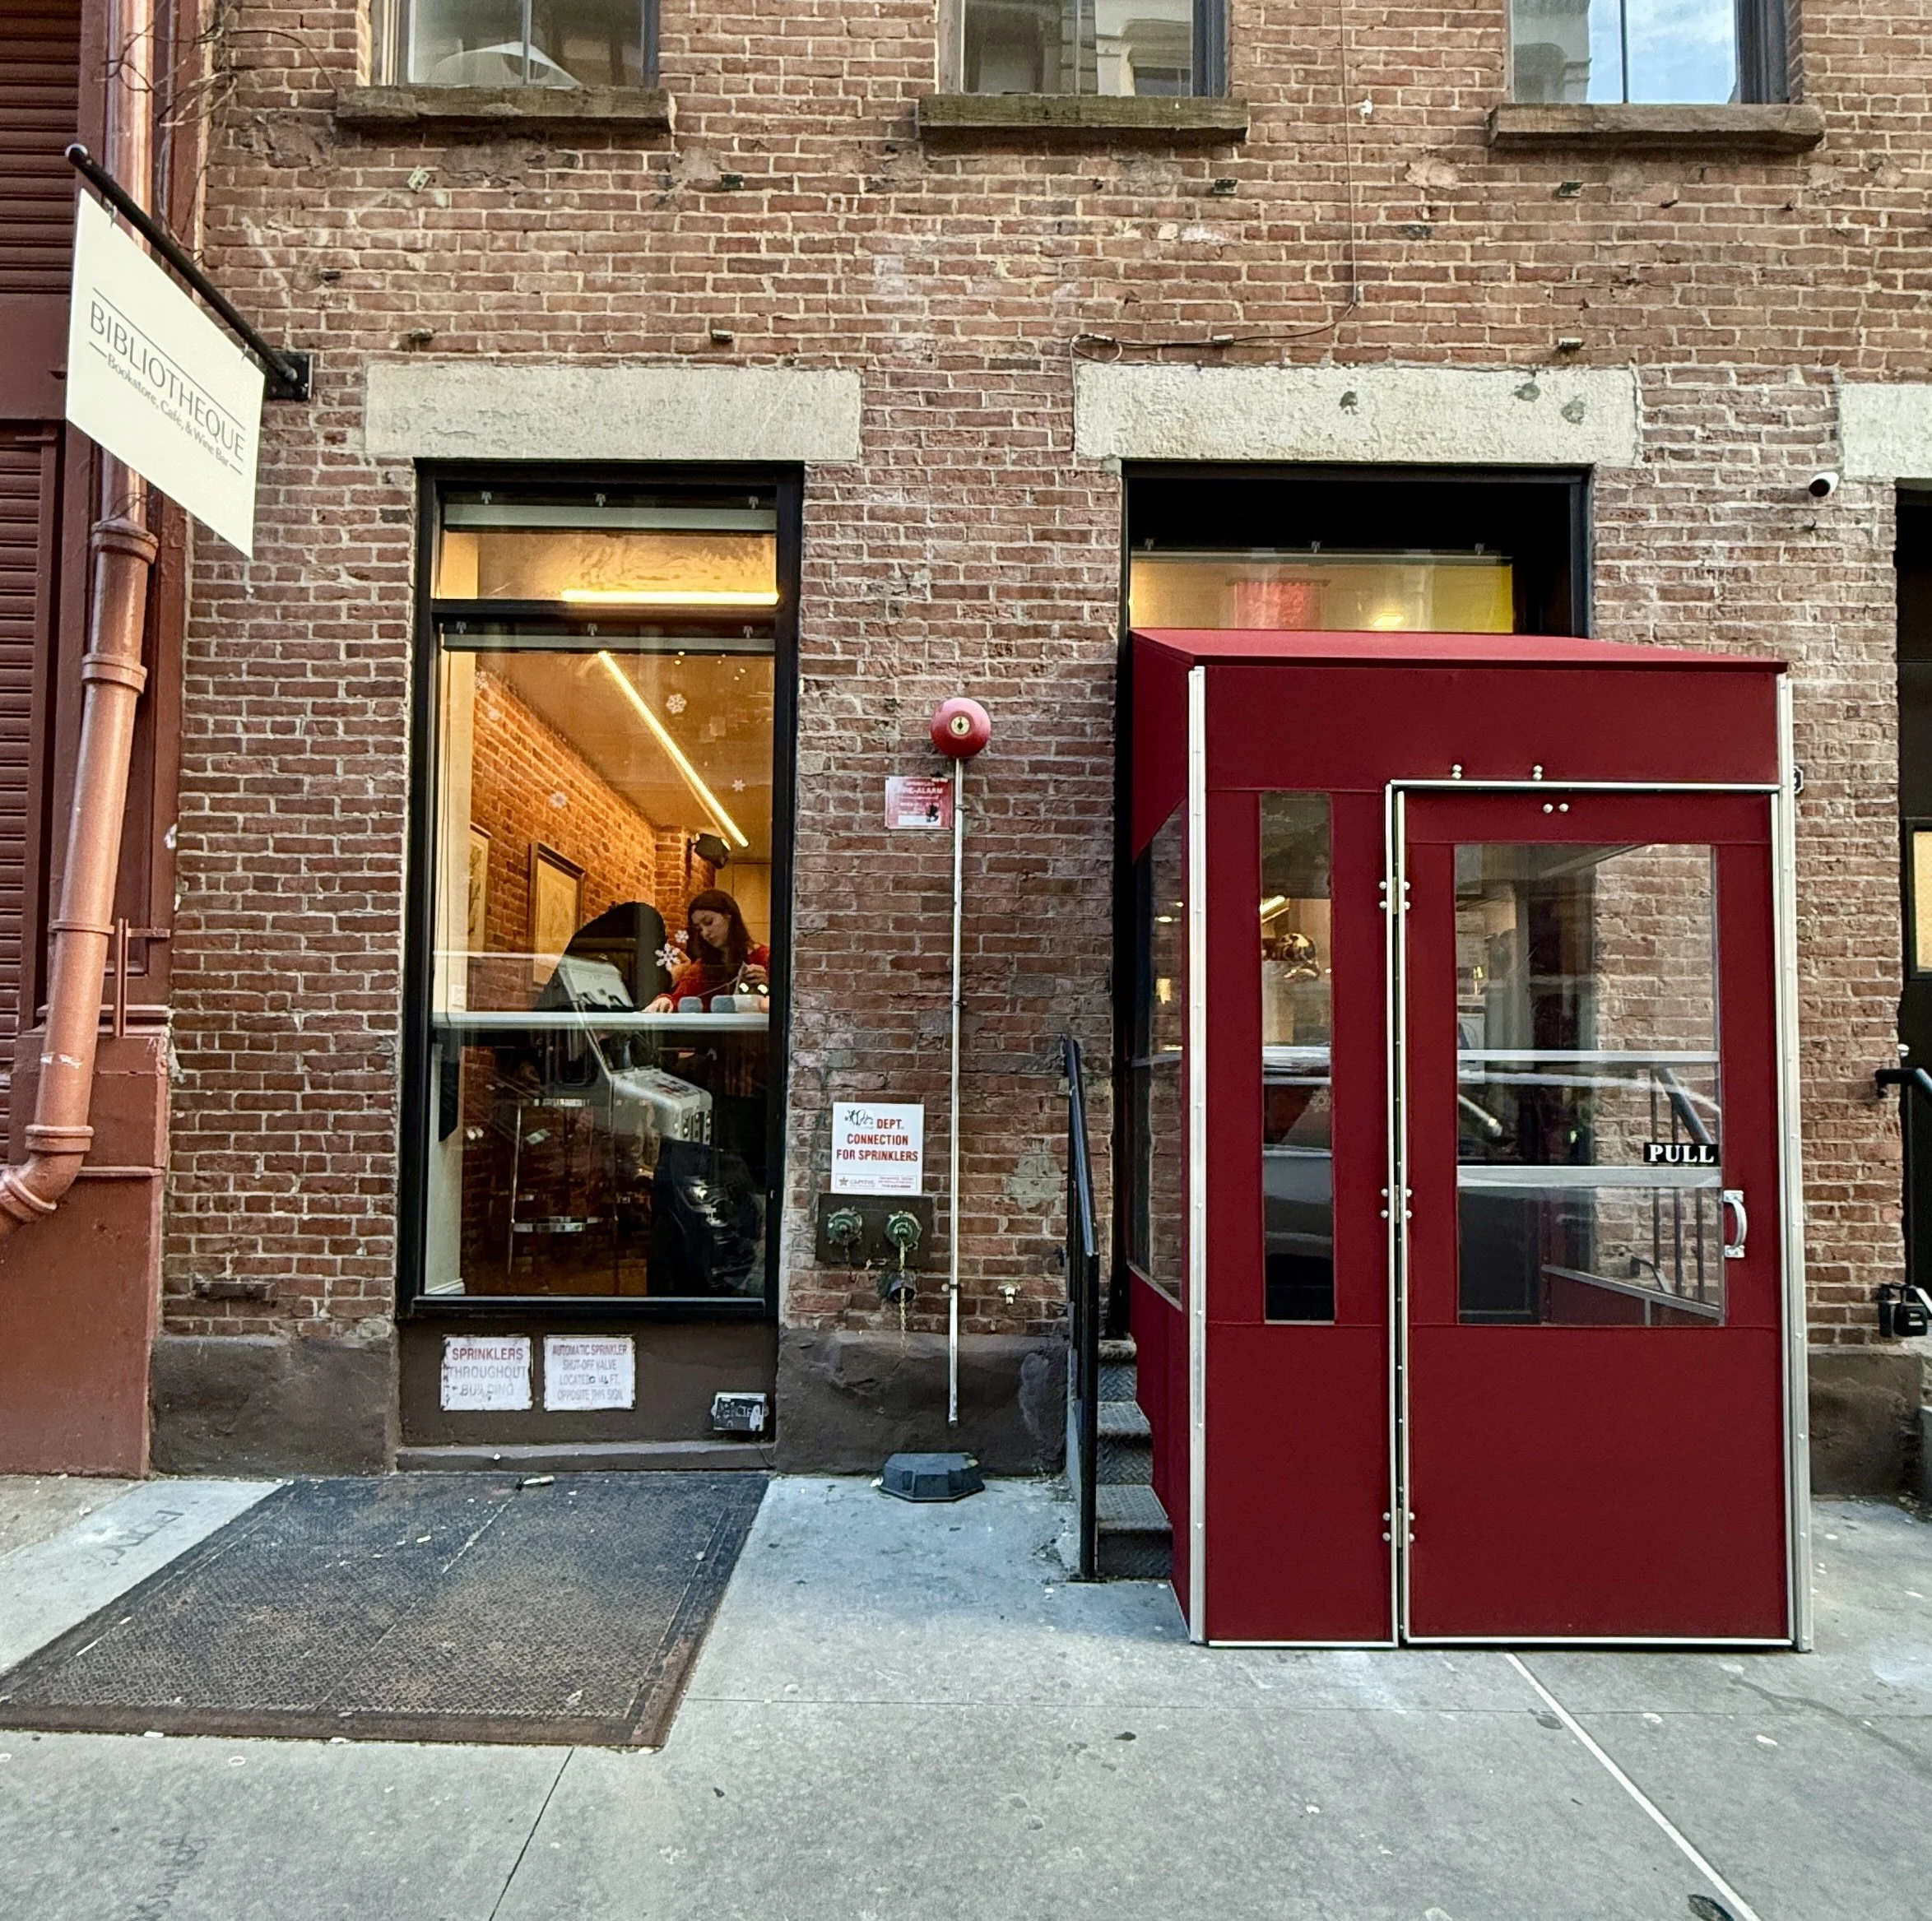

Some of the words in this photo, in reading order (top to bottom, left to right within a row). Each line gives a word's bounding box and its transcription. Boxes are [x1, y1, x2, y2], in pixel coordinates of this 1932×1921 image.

[91, 299, 245, 463] BIBLIOTHEQUE
[107, 352, 160, 409] Bookstore,
[184, 420, 193, 437] &
[193, 427, 215, 455] Wine
[215, 446, 230, 467] Bar
[847, 1133, 909, 1146] CONNECTION
[836, 1148, 856, 1161] FOR
[857, 1149, 919, 1162] SPRINKLERS
[1648, 1144, 1715, 1163] PULL
[452, 1347, 524, 1362] SPRINKLERS
[552, 1343, 590, 1357] AUTOMATIC
[591, 1343, 628, 1357] SPRINKLER
[595, 1358, 618, 1371] VALVE
[448, 1365, 527, 1380] THROUGHOUT
